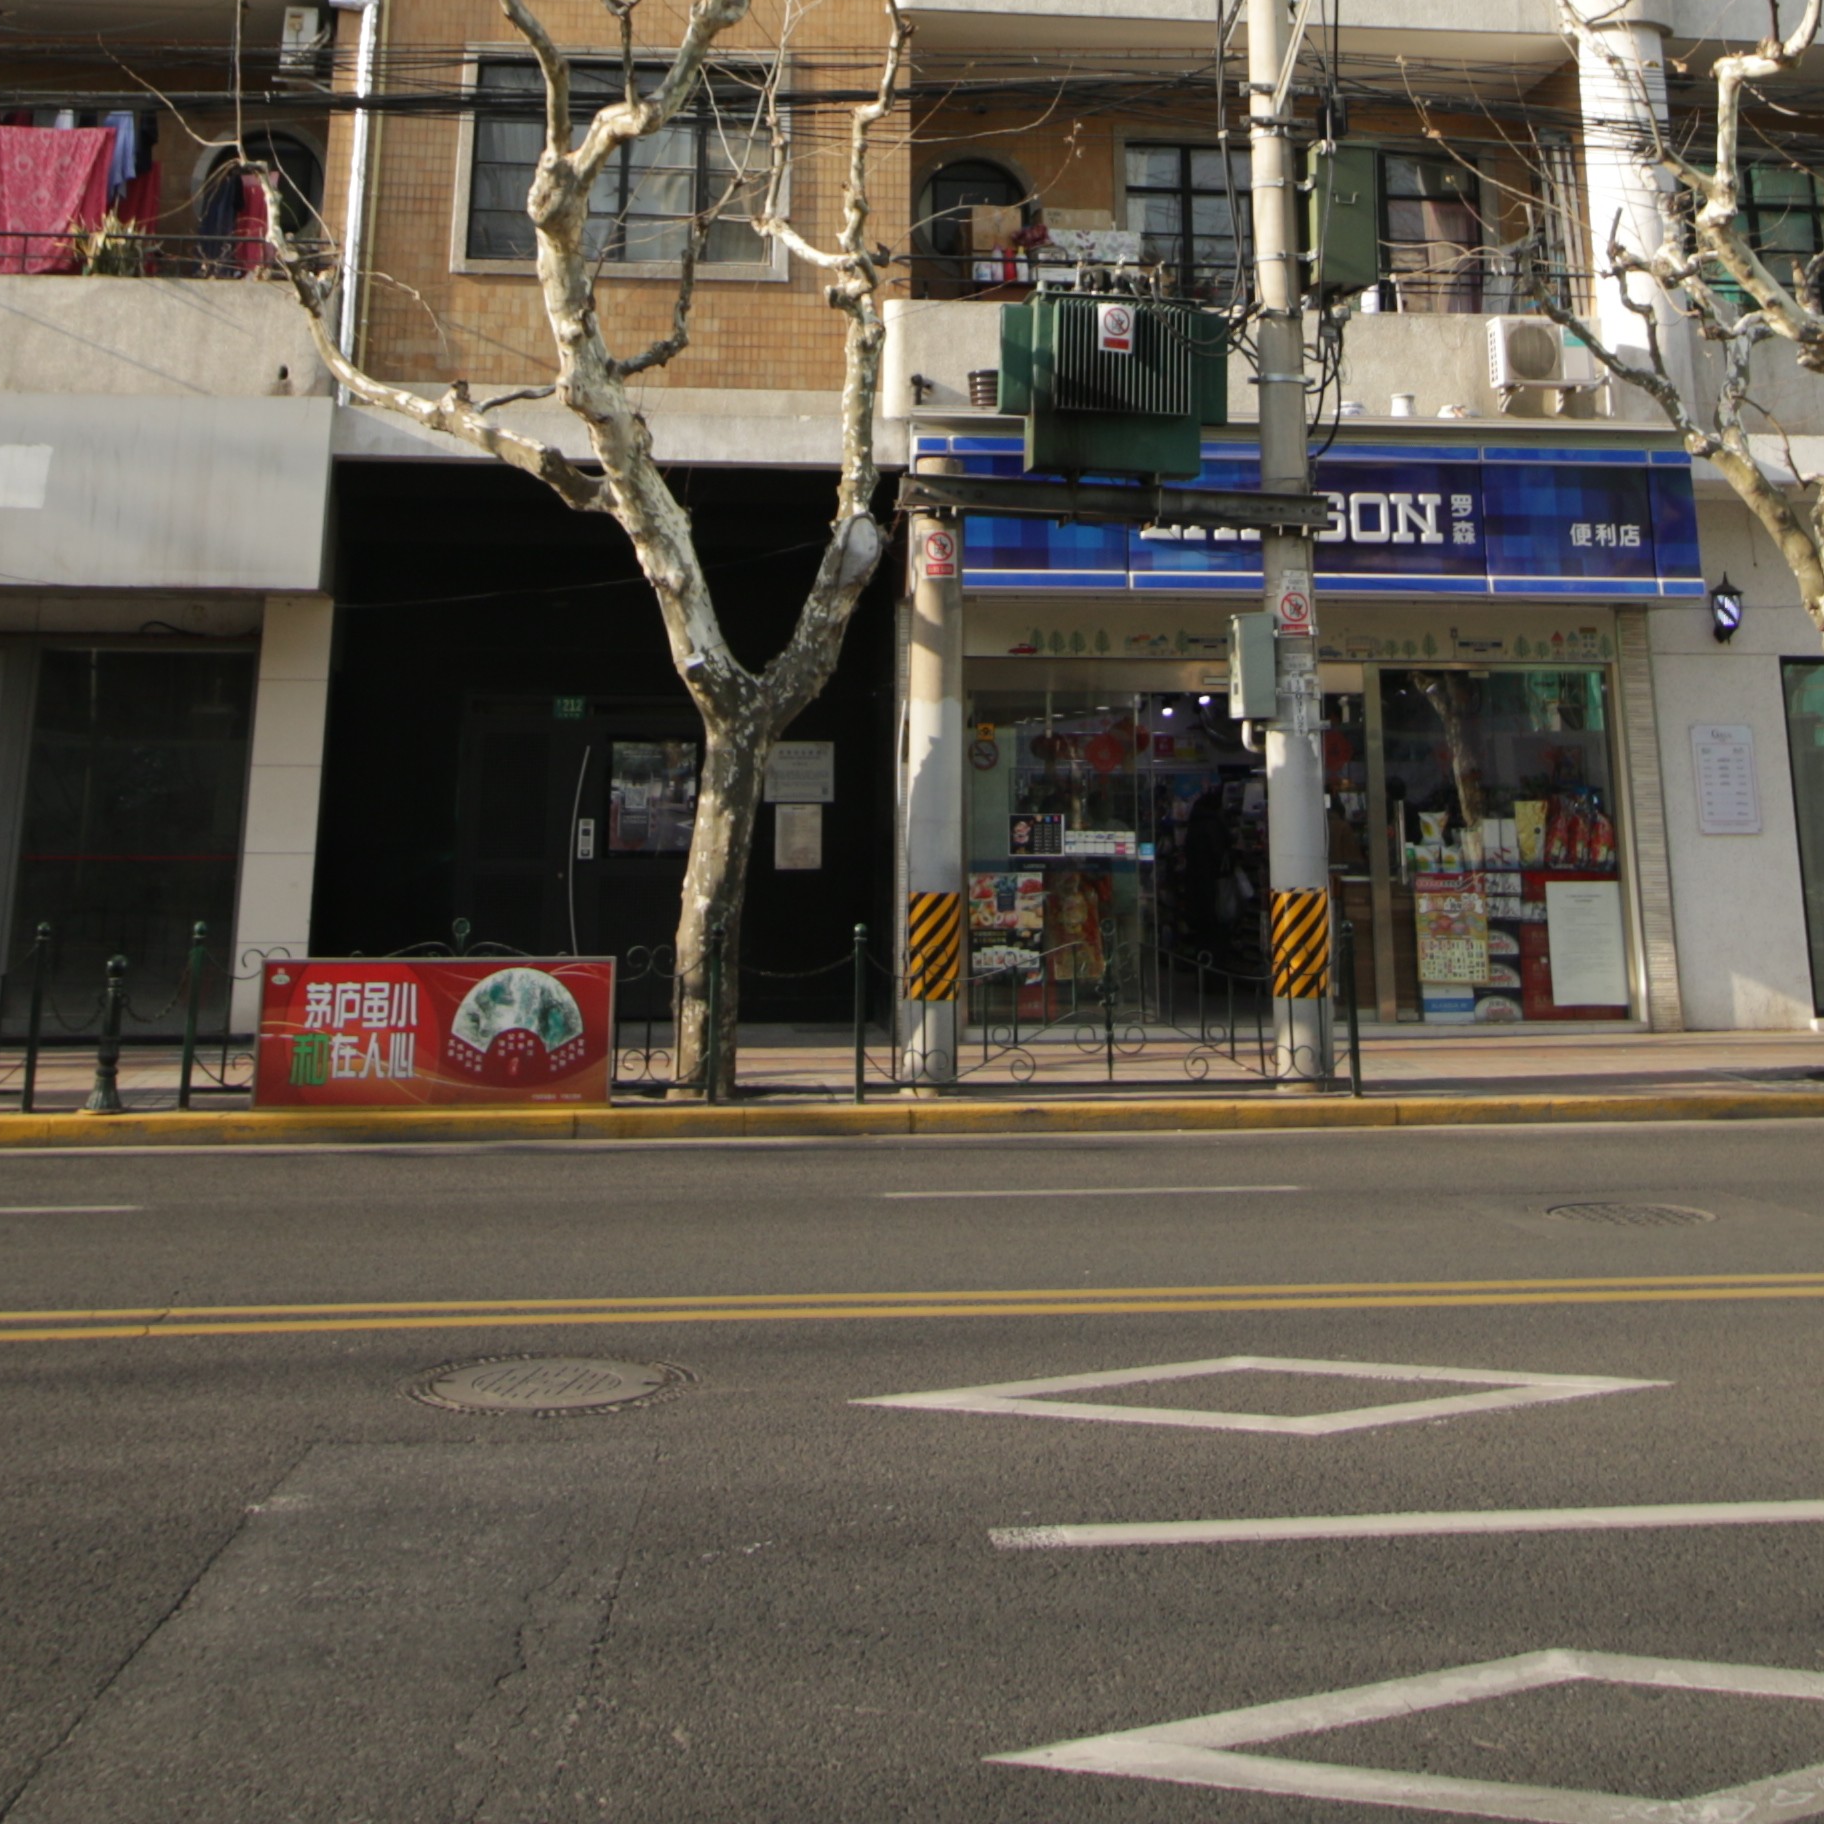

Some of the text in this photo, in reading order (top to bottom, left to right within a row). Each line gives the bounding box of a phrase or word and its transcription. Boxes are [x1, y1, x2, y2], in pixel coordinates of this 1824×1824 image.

[1450, 493, 1476, 545] 罗森
[1569, 521, 1641, 547] 便利店
[304, 981, 418, 1029] 茅庐虽小
[289, 1033, 416, 1087] 和在人心
